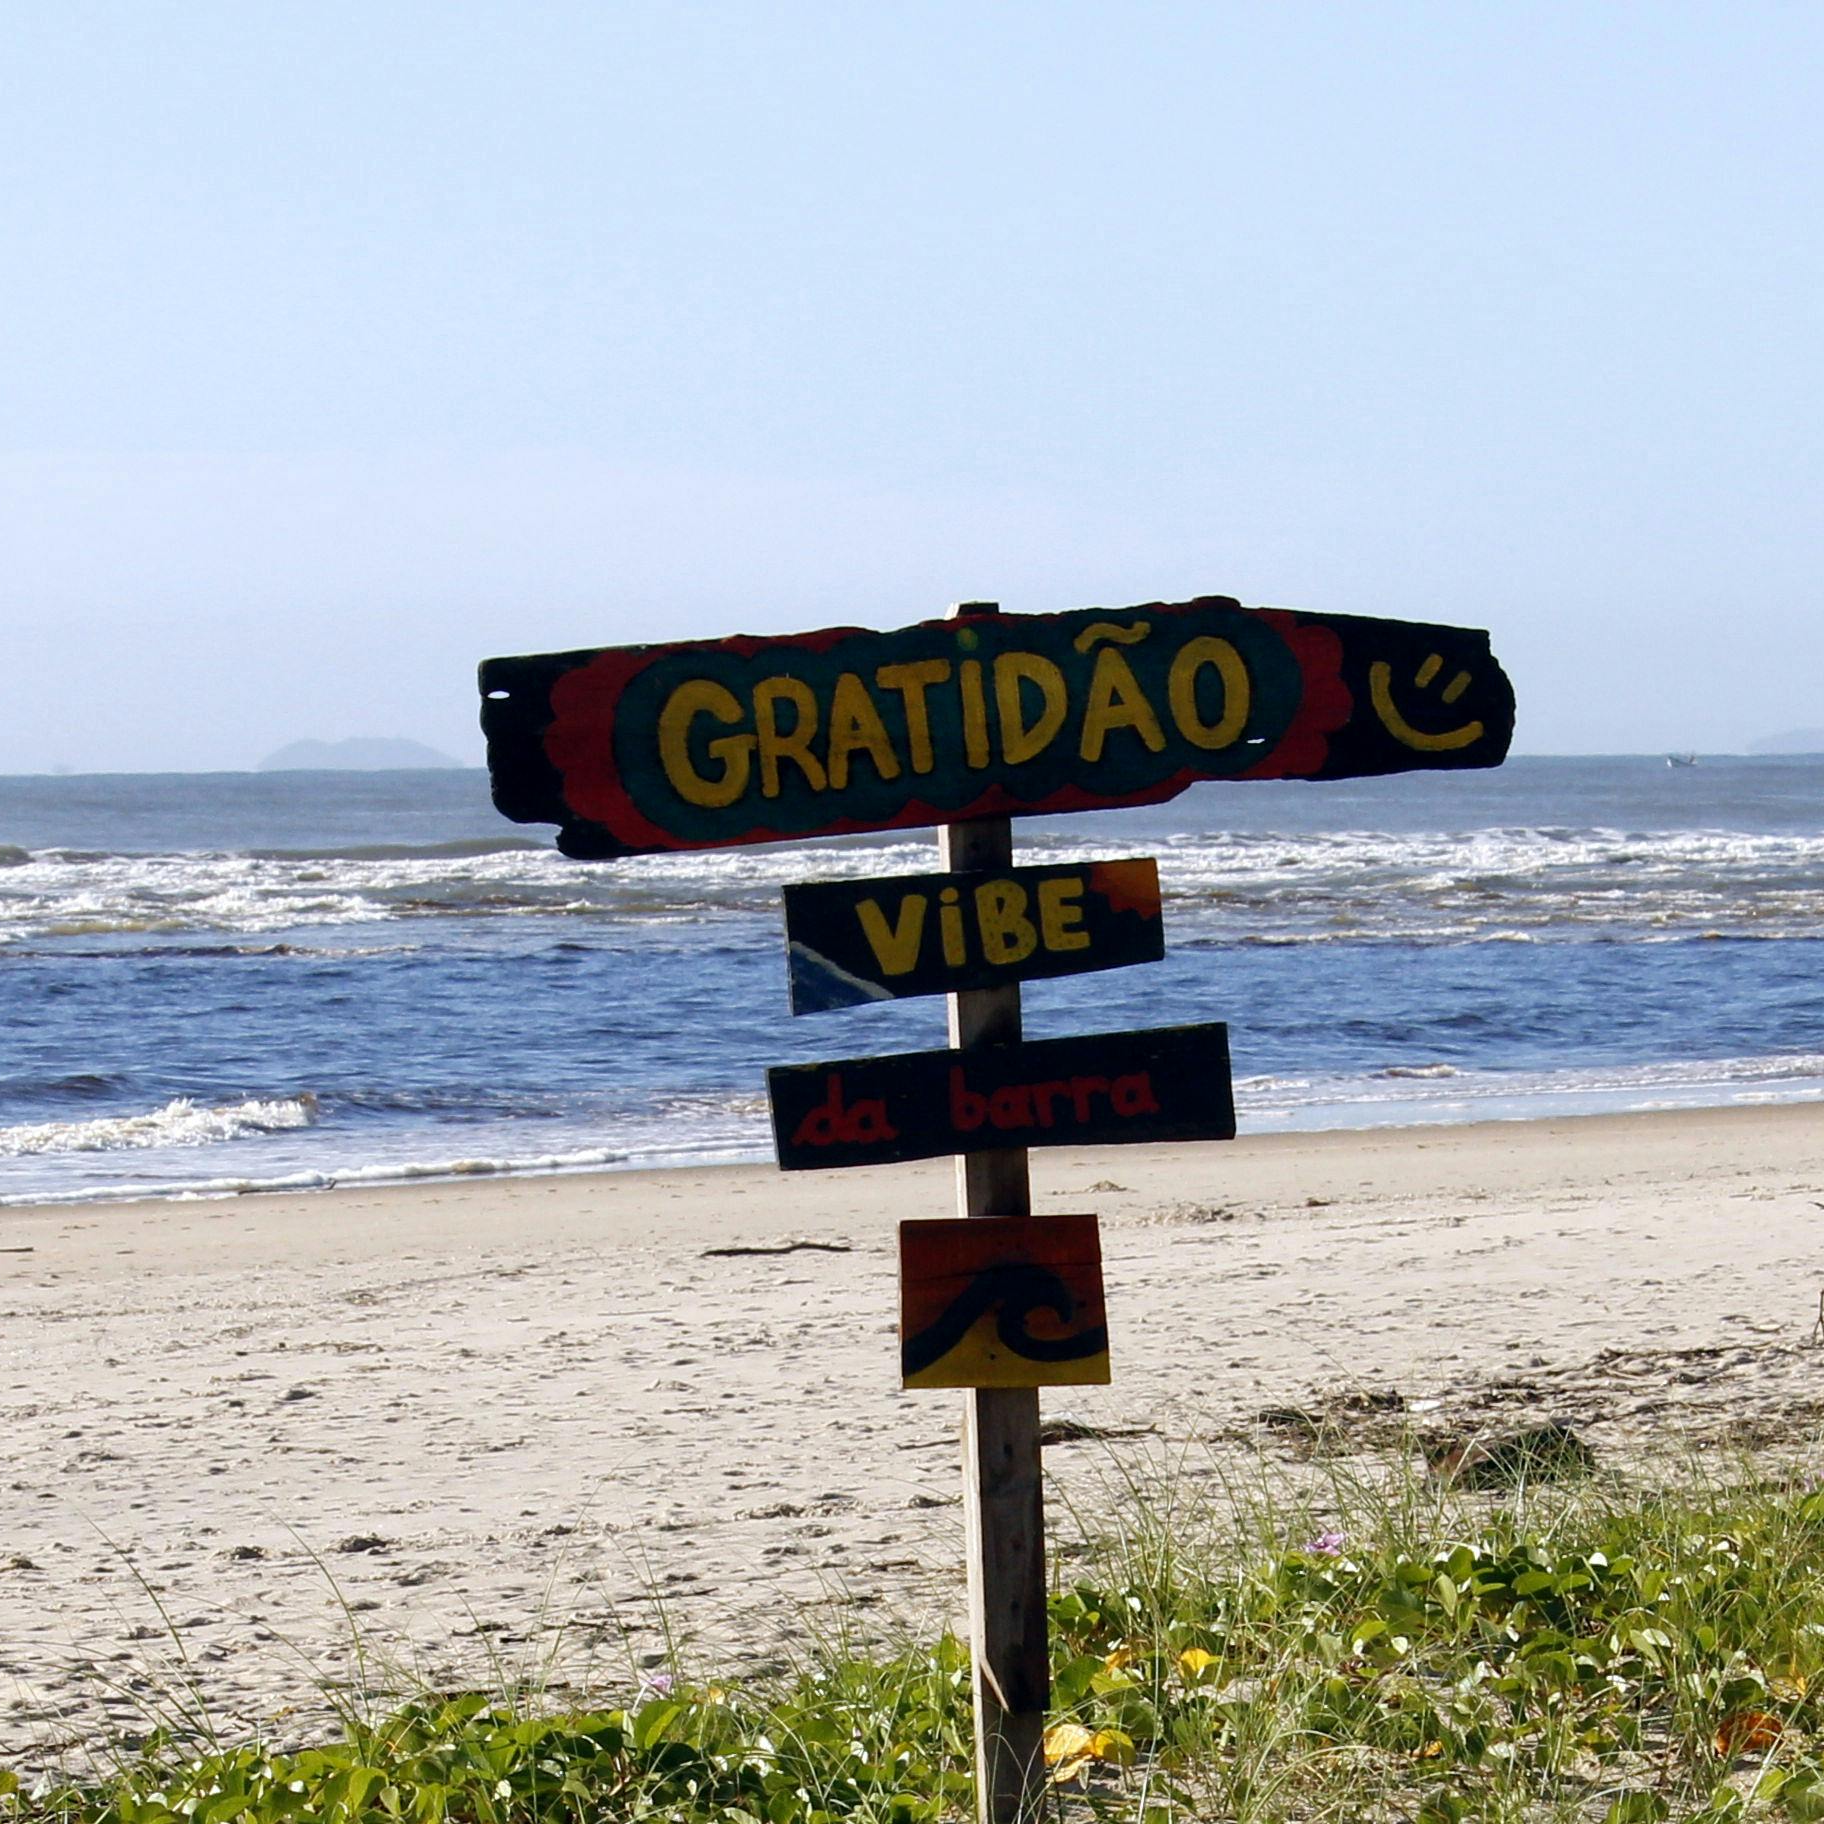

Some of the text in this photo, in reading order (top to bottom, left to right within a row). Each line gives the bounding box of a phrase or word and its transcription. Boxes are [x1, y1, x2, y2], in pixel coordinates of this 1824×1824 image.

[658, 622, 1251, 808] GRATIDÃO
[790, 1066, 1160, 1146] da barra
